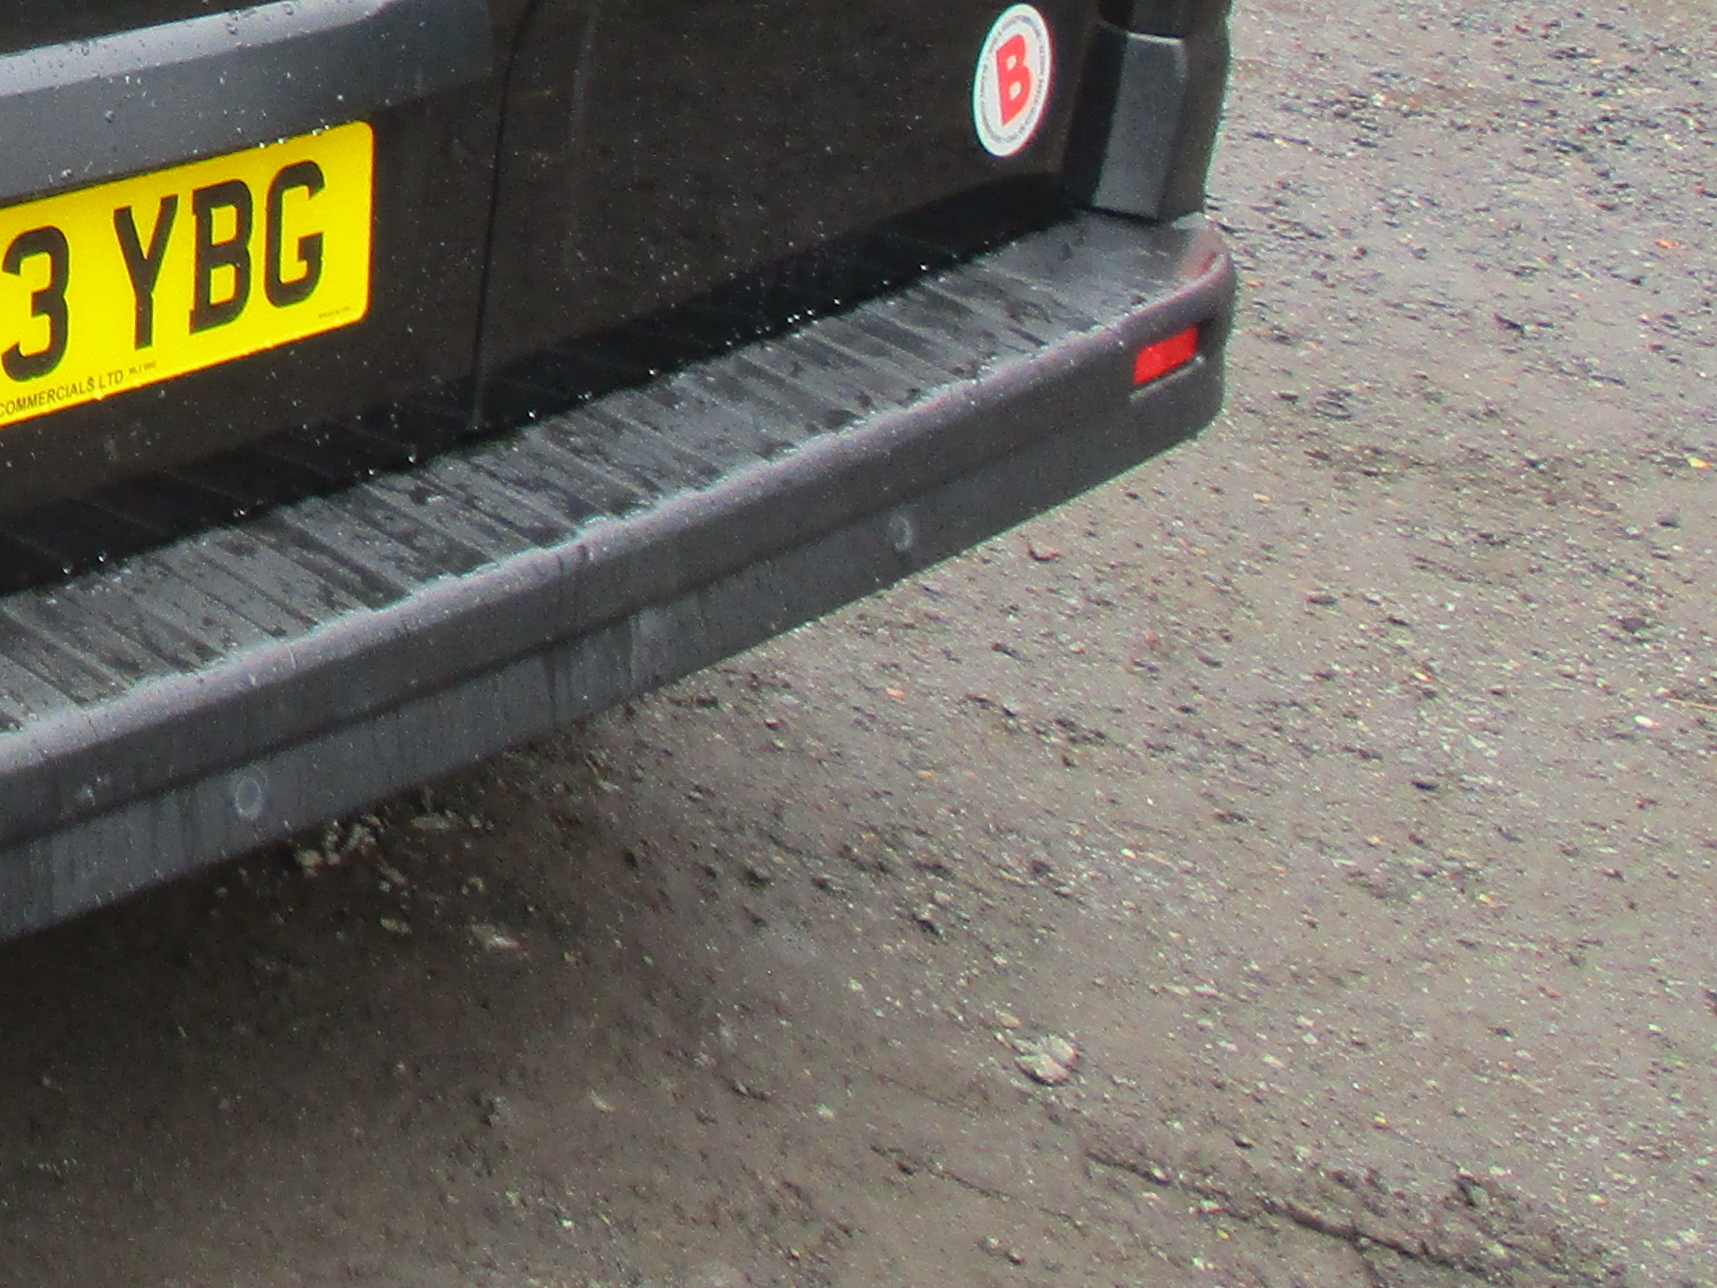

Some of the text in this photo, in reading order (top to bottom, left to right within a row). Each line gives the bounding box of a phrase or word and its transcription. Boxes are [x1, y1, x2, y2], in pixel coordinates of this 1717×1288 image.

[996, 34, 1031, 127] B
[113, 160, 325, 350] YBG
[99, 370, 124, 389] LTD
